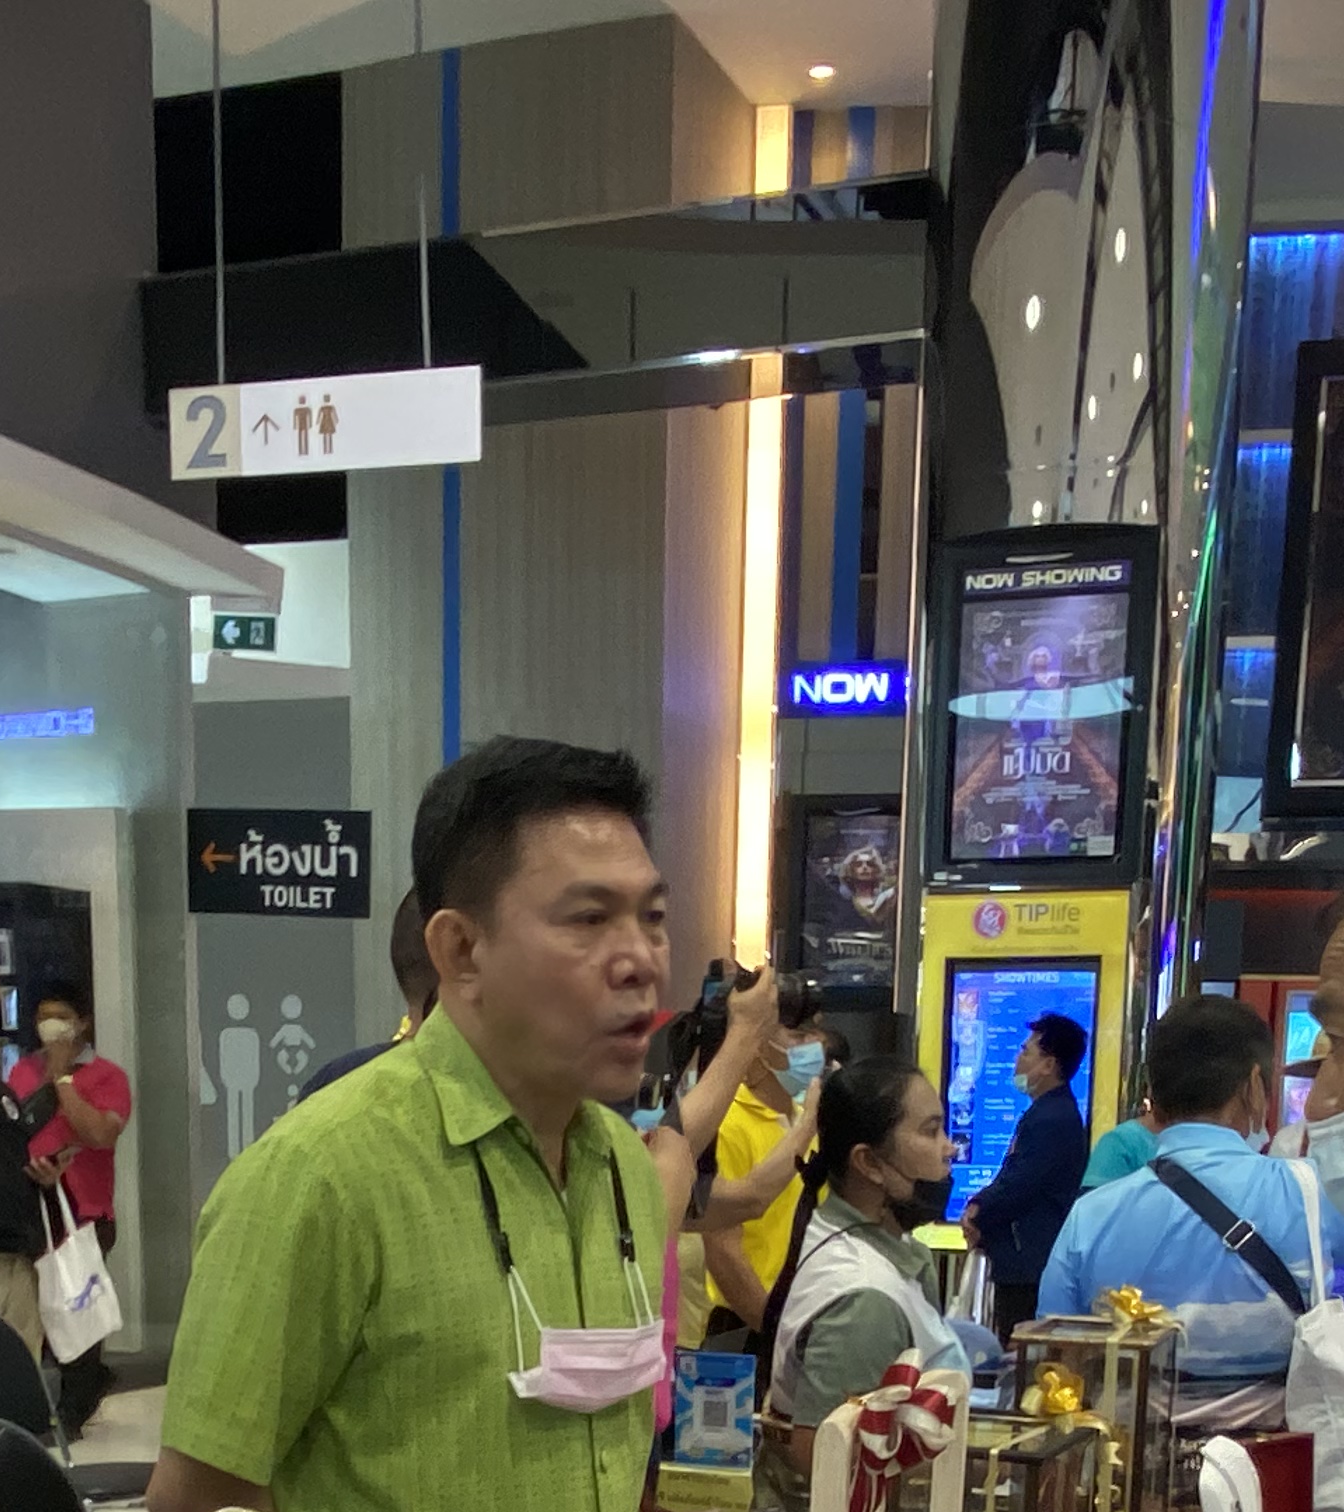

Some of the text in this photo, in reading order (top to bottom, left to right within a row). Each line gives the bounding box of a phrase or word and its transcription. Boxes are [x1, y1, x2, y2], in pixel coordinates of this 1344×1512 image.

[185, 393, 228, 470] 2
[965, 564, 1123, 591] NOW SHOWING
[793, 672, 889, 704] NOW
[238, 818, 359, 878] ห้องน้ำ
[259, 884, 336, 910] TOILET
